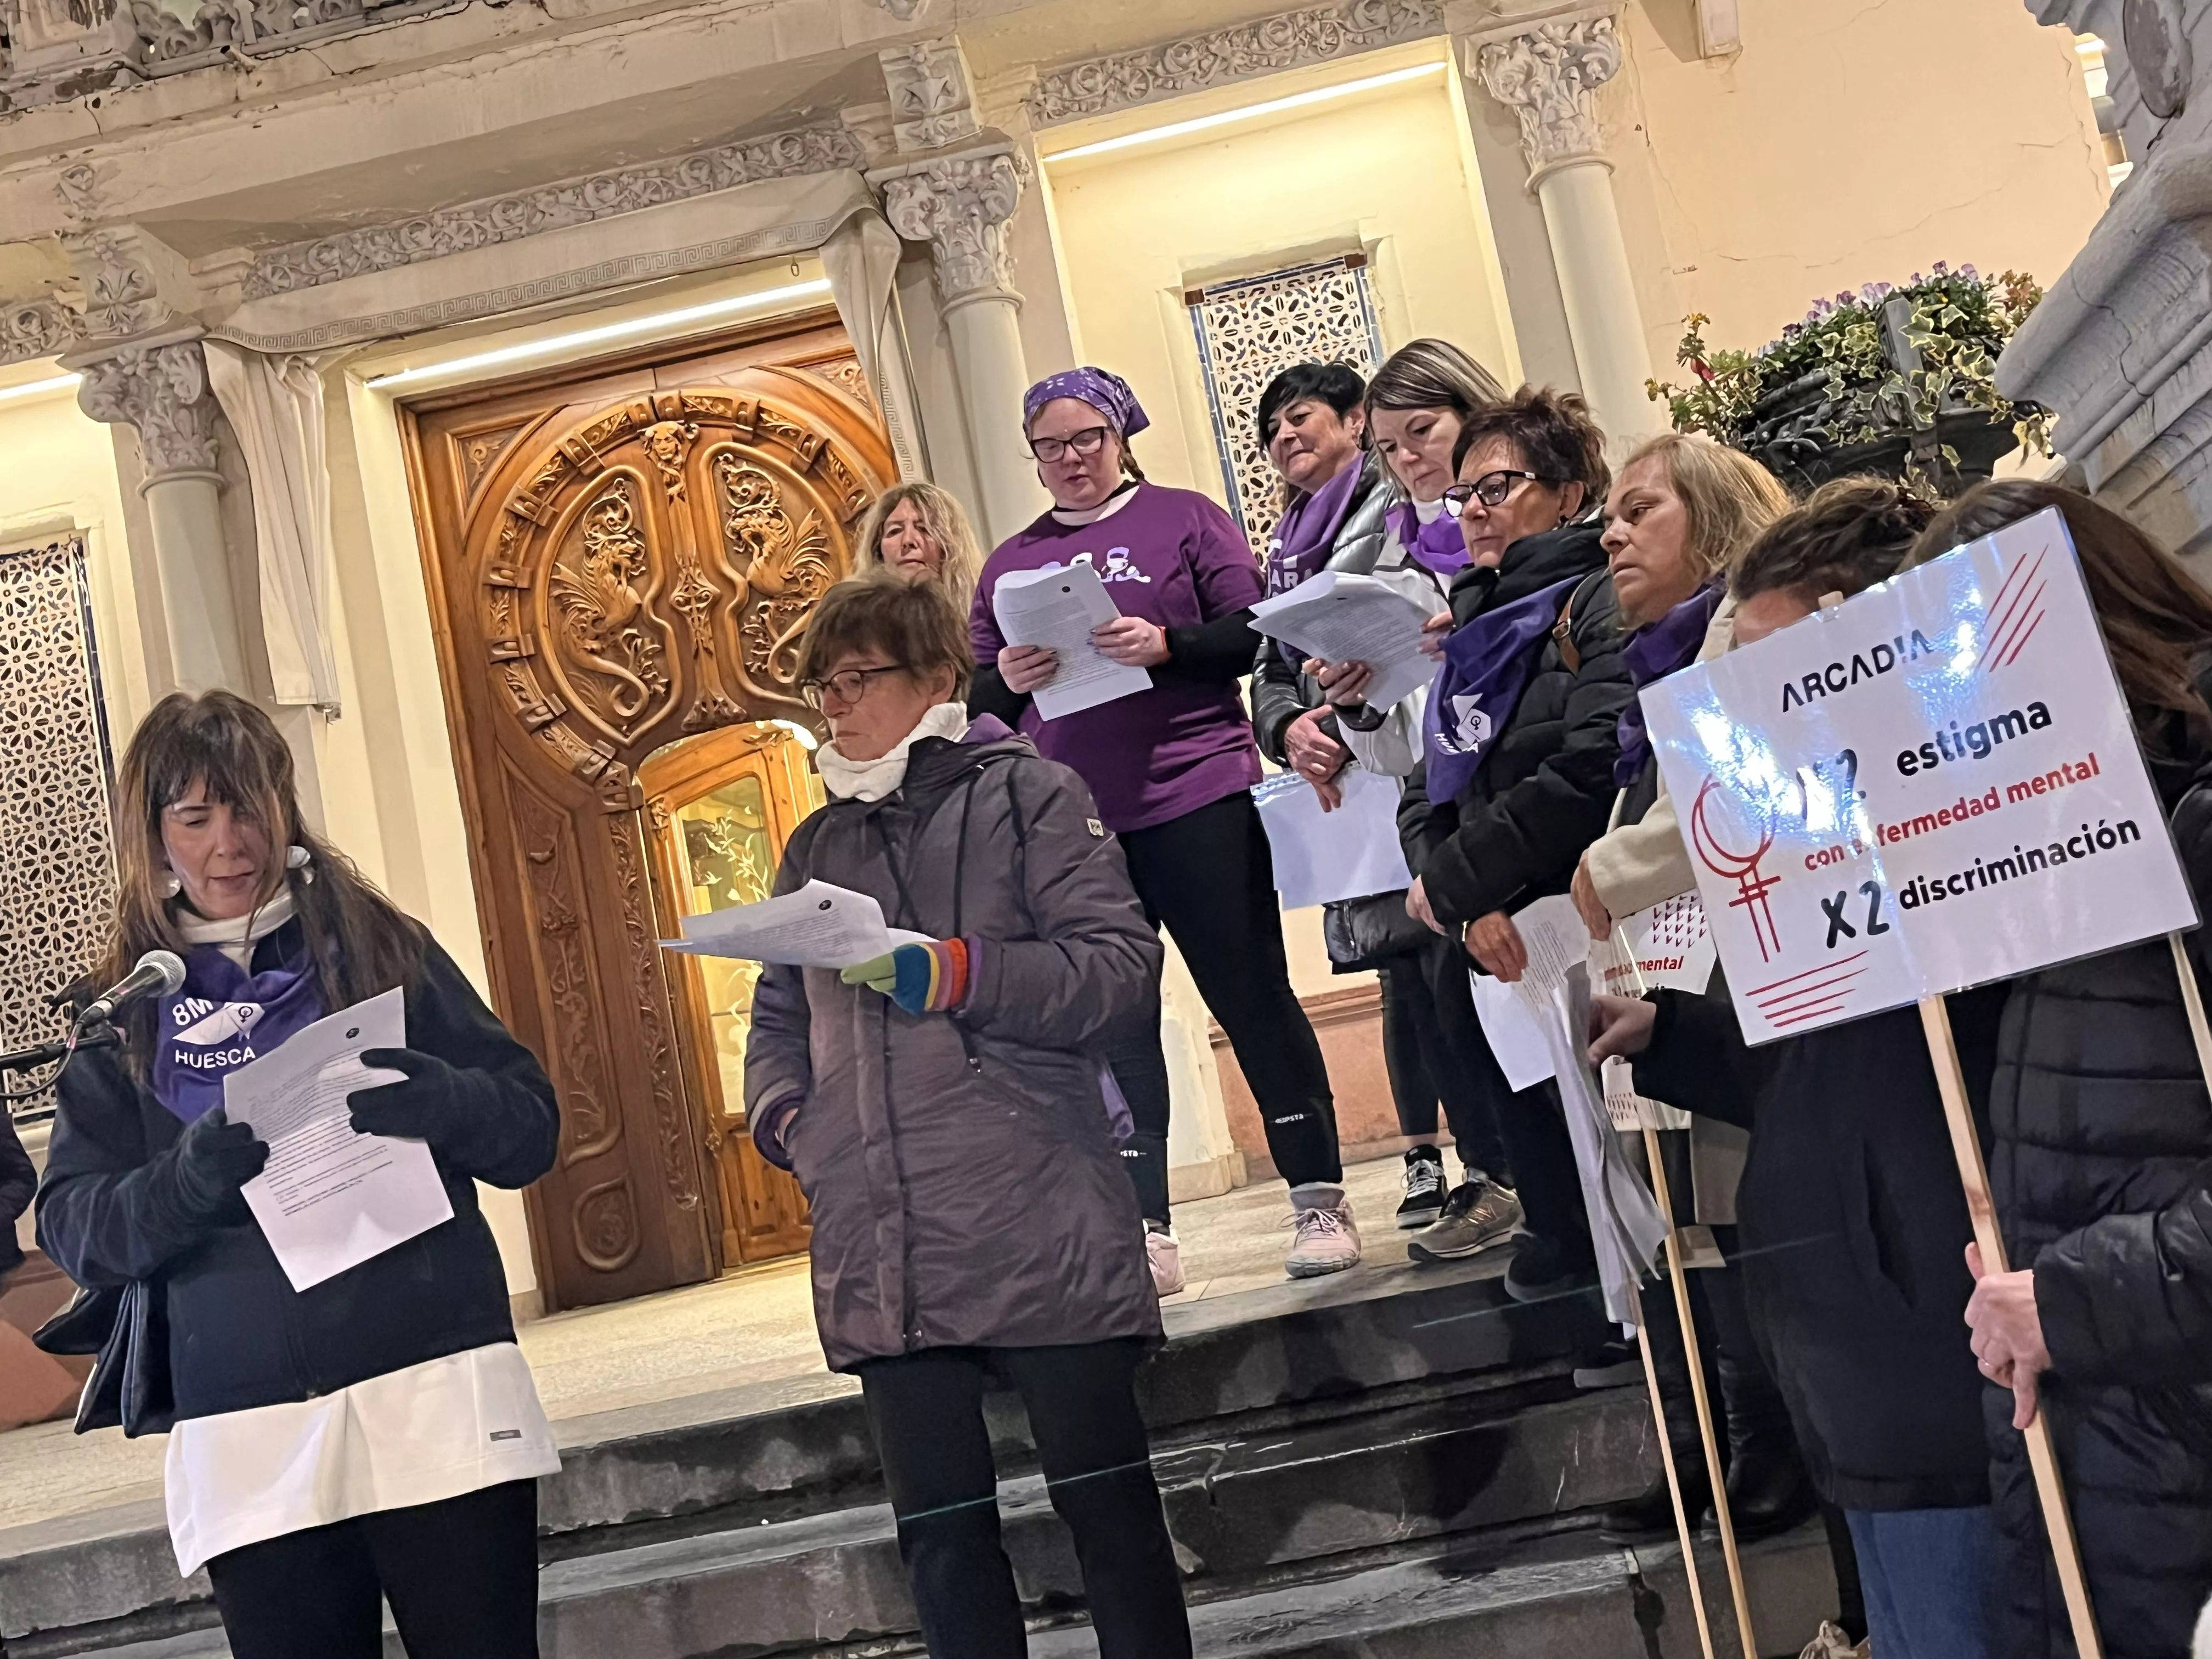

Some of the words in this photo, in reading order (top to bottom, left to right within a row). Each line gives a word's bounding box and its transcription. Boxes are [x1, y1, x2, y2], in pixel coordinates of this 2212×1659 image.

[1897, 701, 2052, 776] estigma
[1804, 845, 1845, 871] con
[1850, 786, 2001, 856] efermedad
[2006, 752, 2101, 804] mental
[1899, 819, 2141, 910] discriminación
[1637, 955, 1684, 972] mental
[172, 997, 213, 1025] 8M
[175, 1046, 256, 1069] HUESCA
